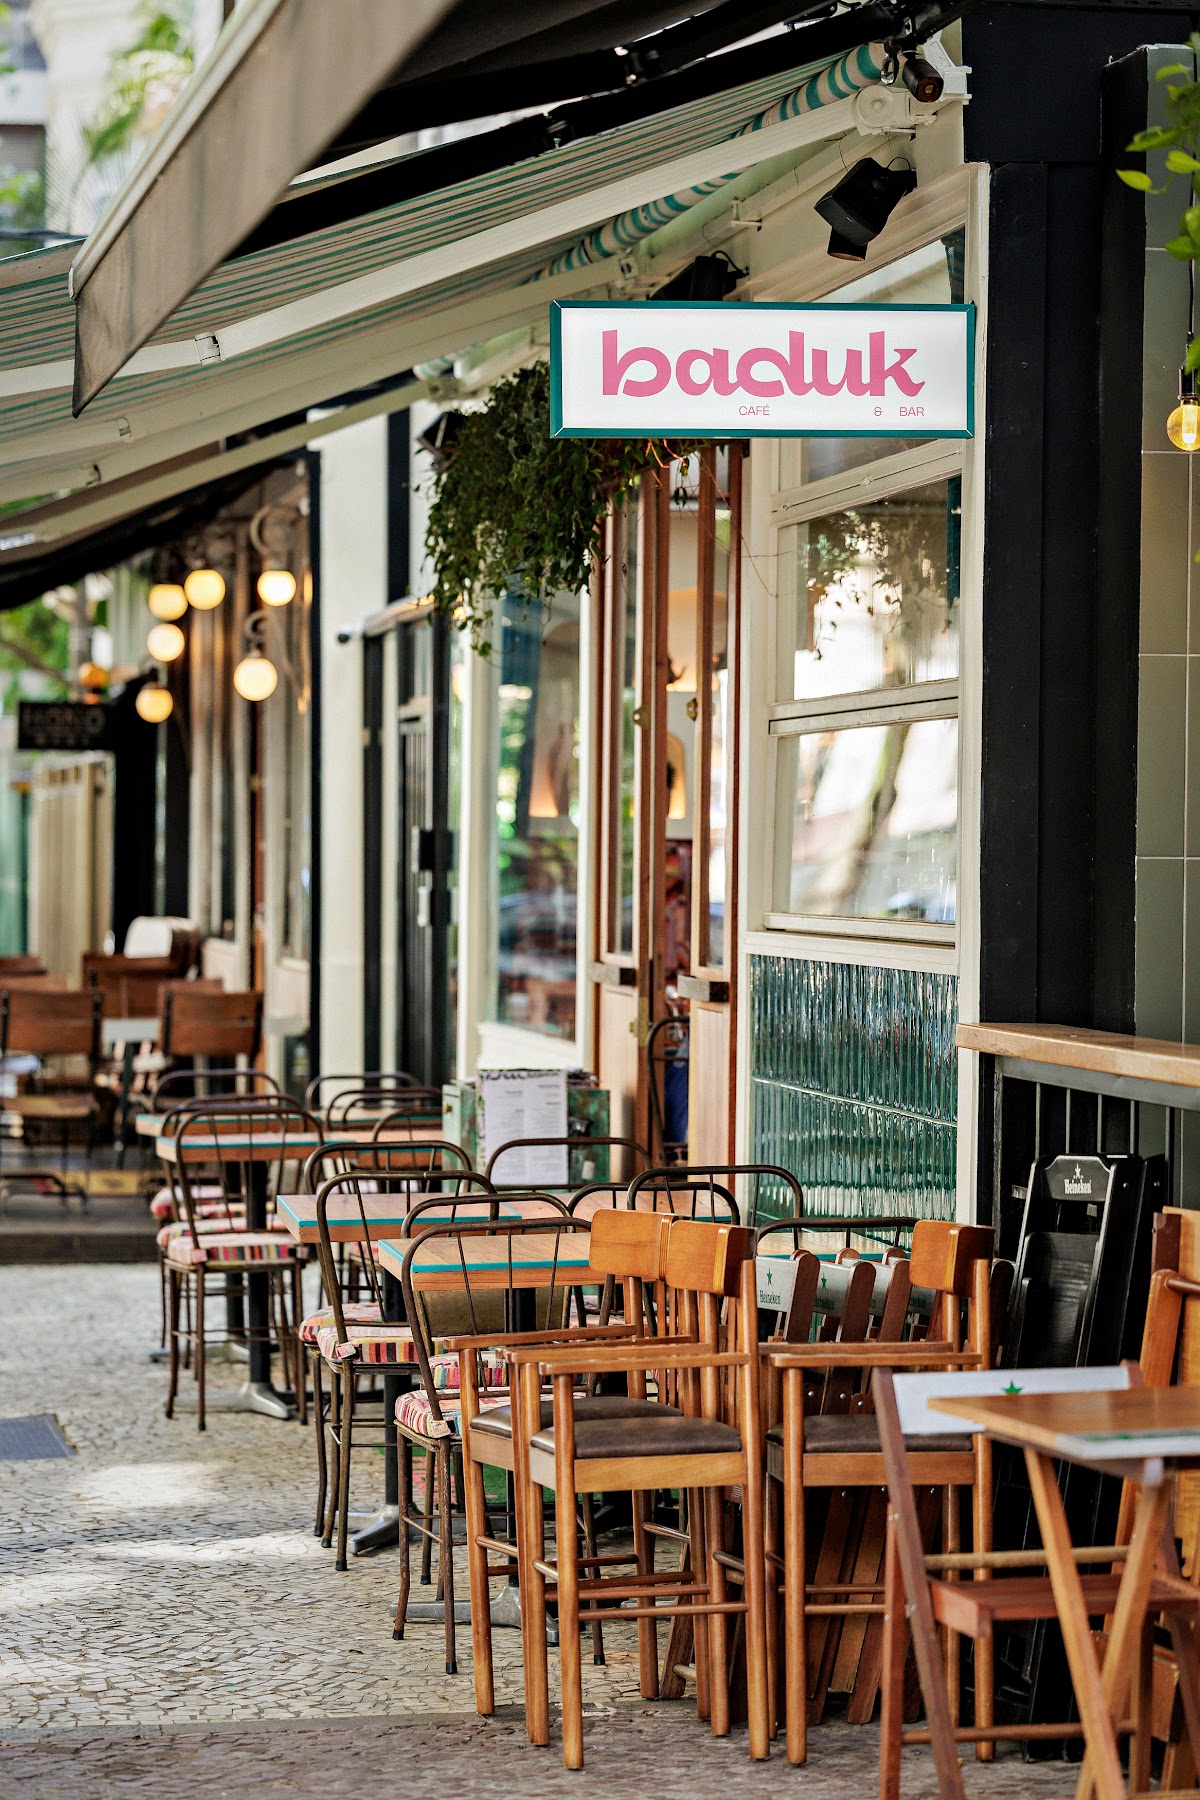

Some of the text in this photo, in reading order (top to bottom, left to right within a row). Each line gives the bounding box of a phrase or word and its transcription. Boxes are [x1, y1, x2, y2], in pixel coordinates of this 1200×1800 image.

[602, 329, 926, 397] baduk
[738, 404, 925, 417] CAFÉ & BAR
[1064, 1179, 1092, 1194] Heineken
[760, 1290, 782, 1305] Heineken
